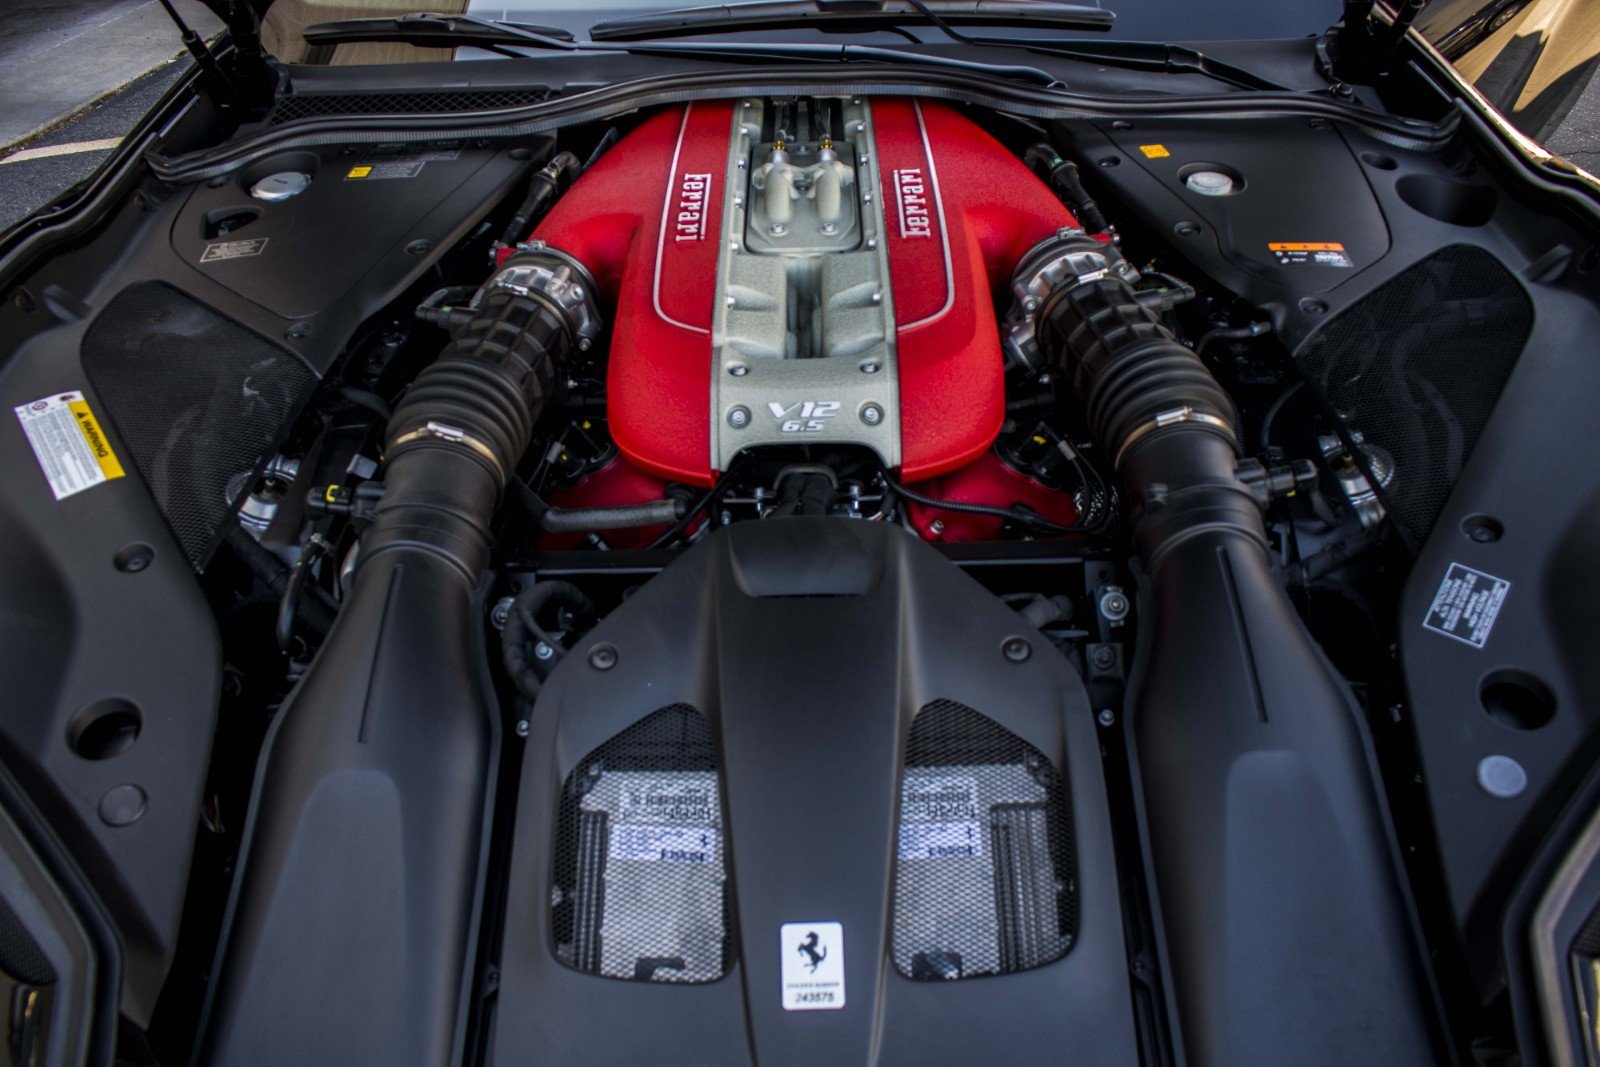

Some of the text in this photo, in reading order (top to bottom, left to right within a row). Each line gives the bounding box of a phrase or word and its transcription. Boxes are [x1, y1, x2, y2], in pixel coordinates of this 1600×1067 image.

[675, 173, 712, 243] Ferrari
[893, 168, 931, 239] Ferrari
[767, 401, 841, 418] V12
[781, 420, 824, 432] 6.5
[82, 419, 109, 458] WARNING
